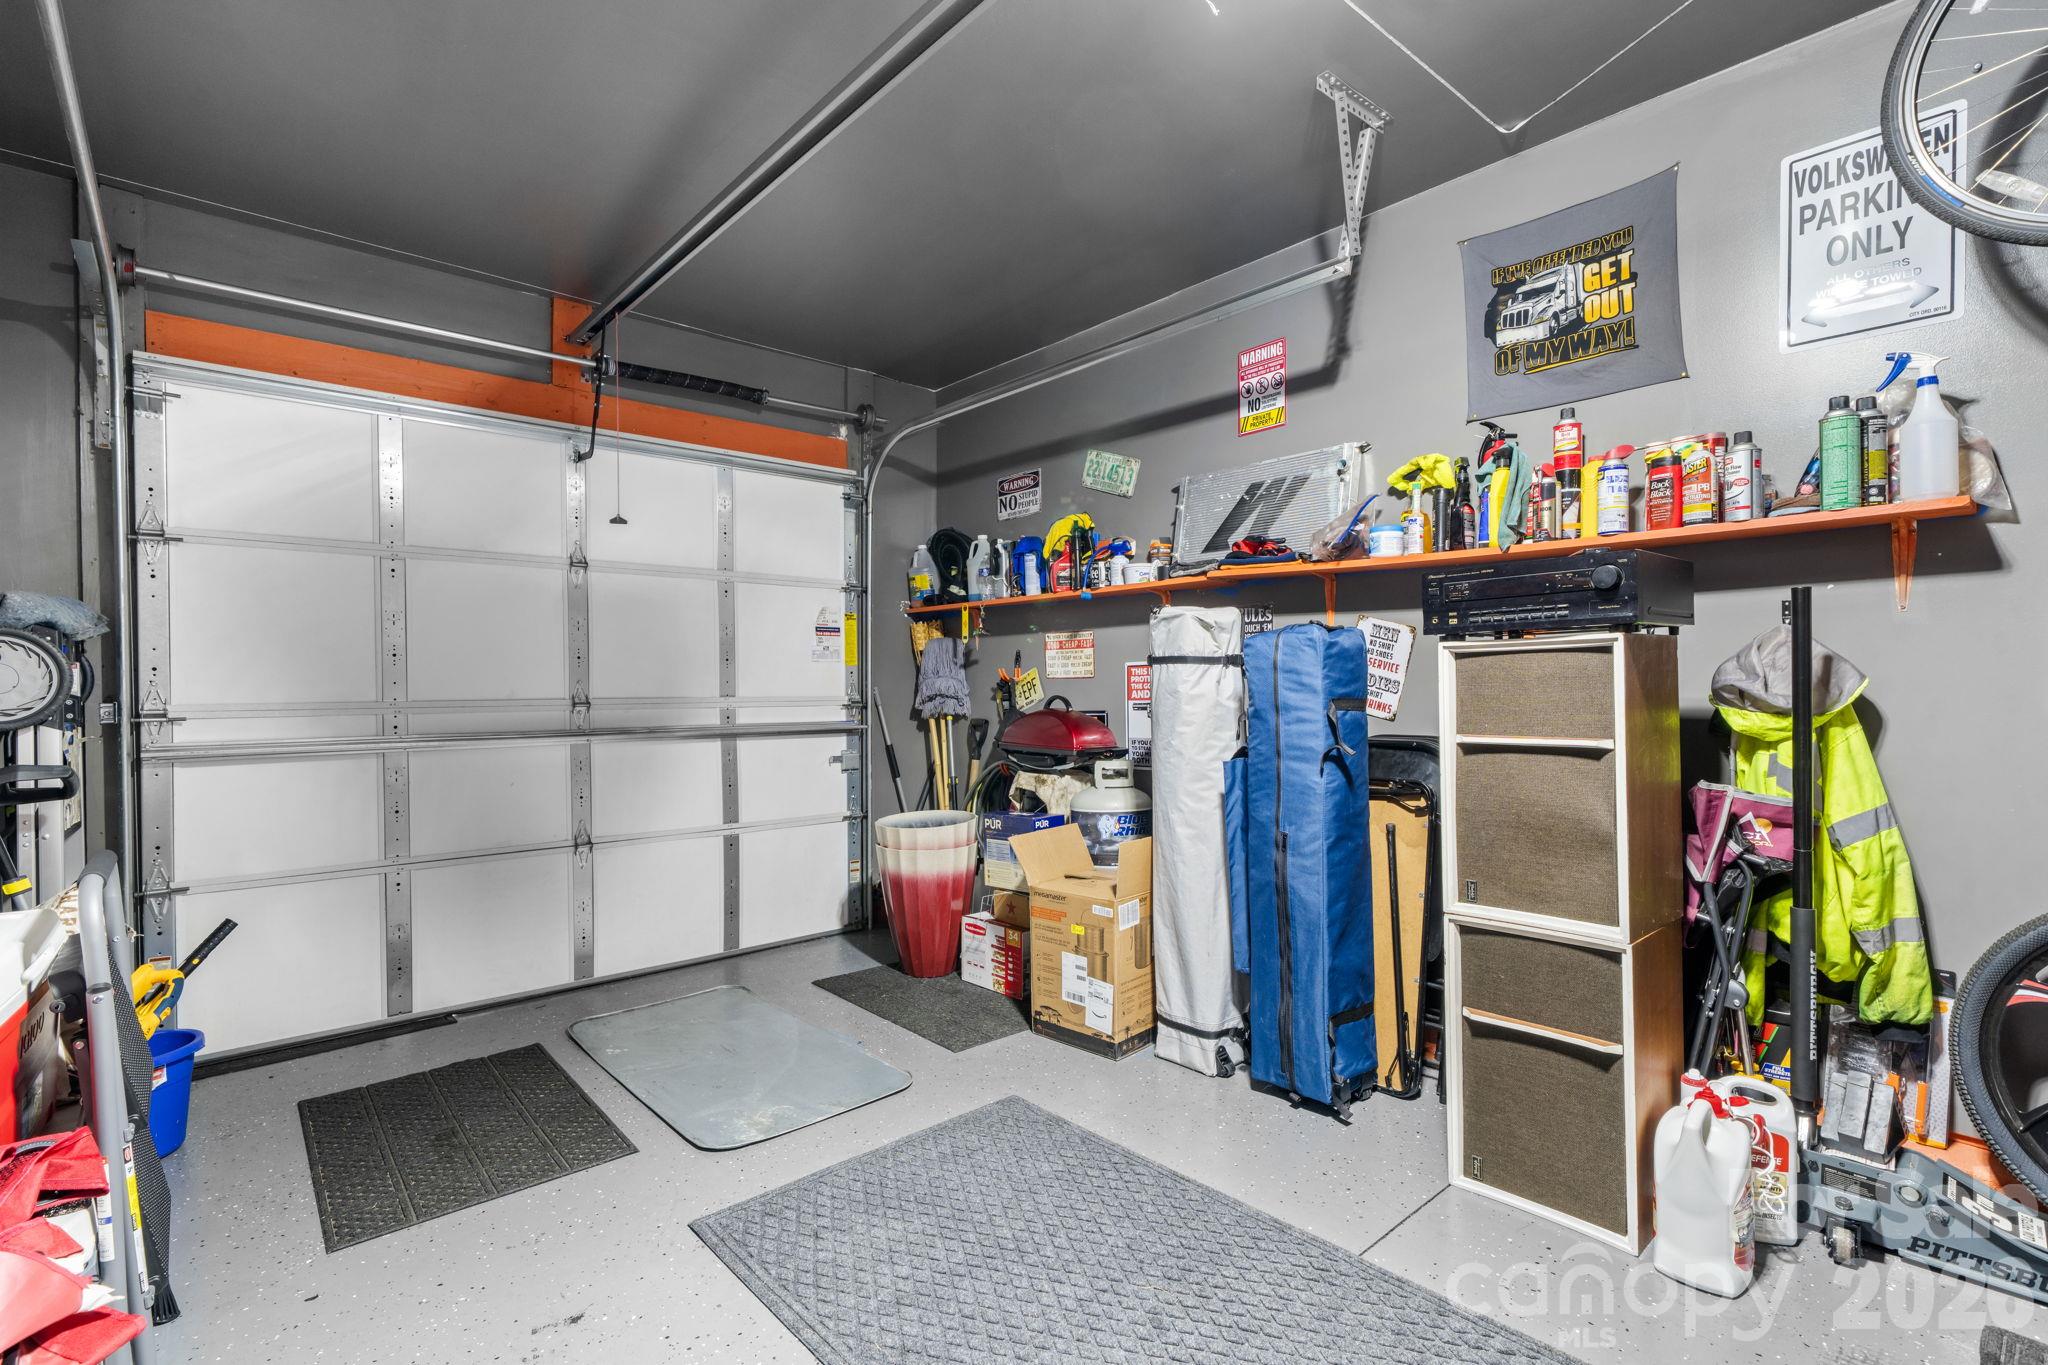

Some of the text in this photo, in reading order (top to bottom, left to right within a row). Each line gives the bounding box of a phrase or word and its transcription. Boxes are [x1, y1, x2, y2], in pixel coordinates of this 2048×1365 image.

[1793, 123, 1950, 198] VOLKSWEN
[1907, 154, 1926, 176] GIANT
[1799, 177, 1904, 236] PARKI
[1826, 216, 1914, 267] ONLY
[1491, 267, 1504, 287] IF
[1532, 238, 1601, 275] OFFENDED
[1602, 225, 1633, 250] YOU
[1583, 249, 1634, 292] GET
[1871, 267, 1922, 286] TOWED
[1584, 282, 1637, 323] OUT
[1495, 316, 1636, 376] OF MY WAY!
[1241, 342, 1283, 367] WARNING
[1247, 397, 1260, 413] NO
[1250, 418, 1274, 430] PROPERTY
[1003, 477, 1034, 491] WARNING
[1651, 480, 1670, 490] Back
[1698, 483, 1710, 492] PB
[1018, 490, 1038, 500] STUPID
[1651, 489, 1671, 498] Black
[999, 495, 1018, 513] NO
[1018, 498, 1039, 509] PEOPLE
[1244, 624, 1260, 632] OUCH
[1370, 623, 1400, 643] MEN
[1369, 639, 1394, 651] NO SHIRT
[1376, 649, 1393, 660] SHOES
[1368, 657, 1399, 674] SERVICE
[1021, 677, 1037, 700] EPF
[1367, 673, 1400, 694] DIES
[1132, 690, 1150, 698] AND
[1367, 699, 1392, 714] RINKS
[1033, 890, 1067, 902] megamaster
[1008, 929, 1018, 941] 34
[1751, 1154, 1783, 1166] EFENE
